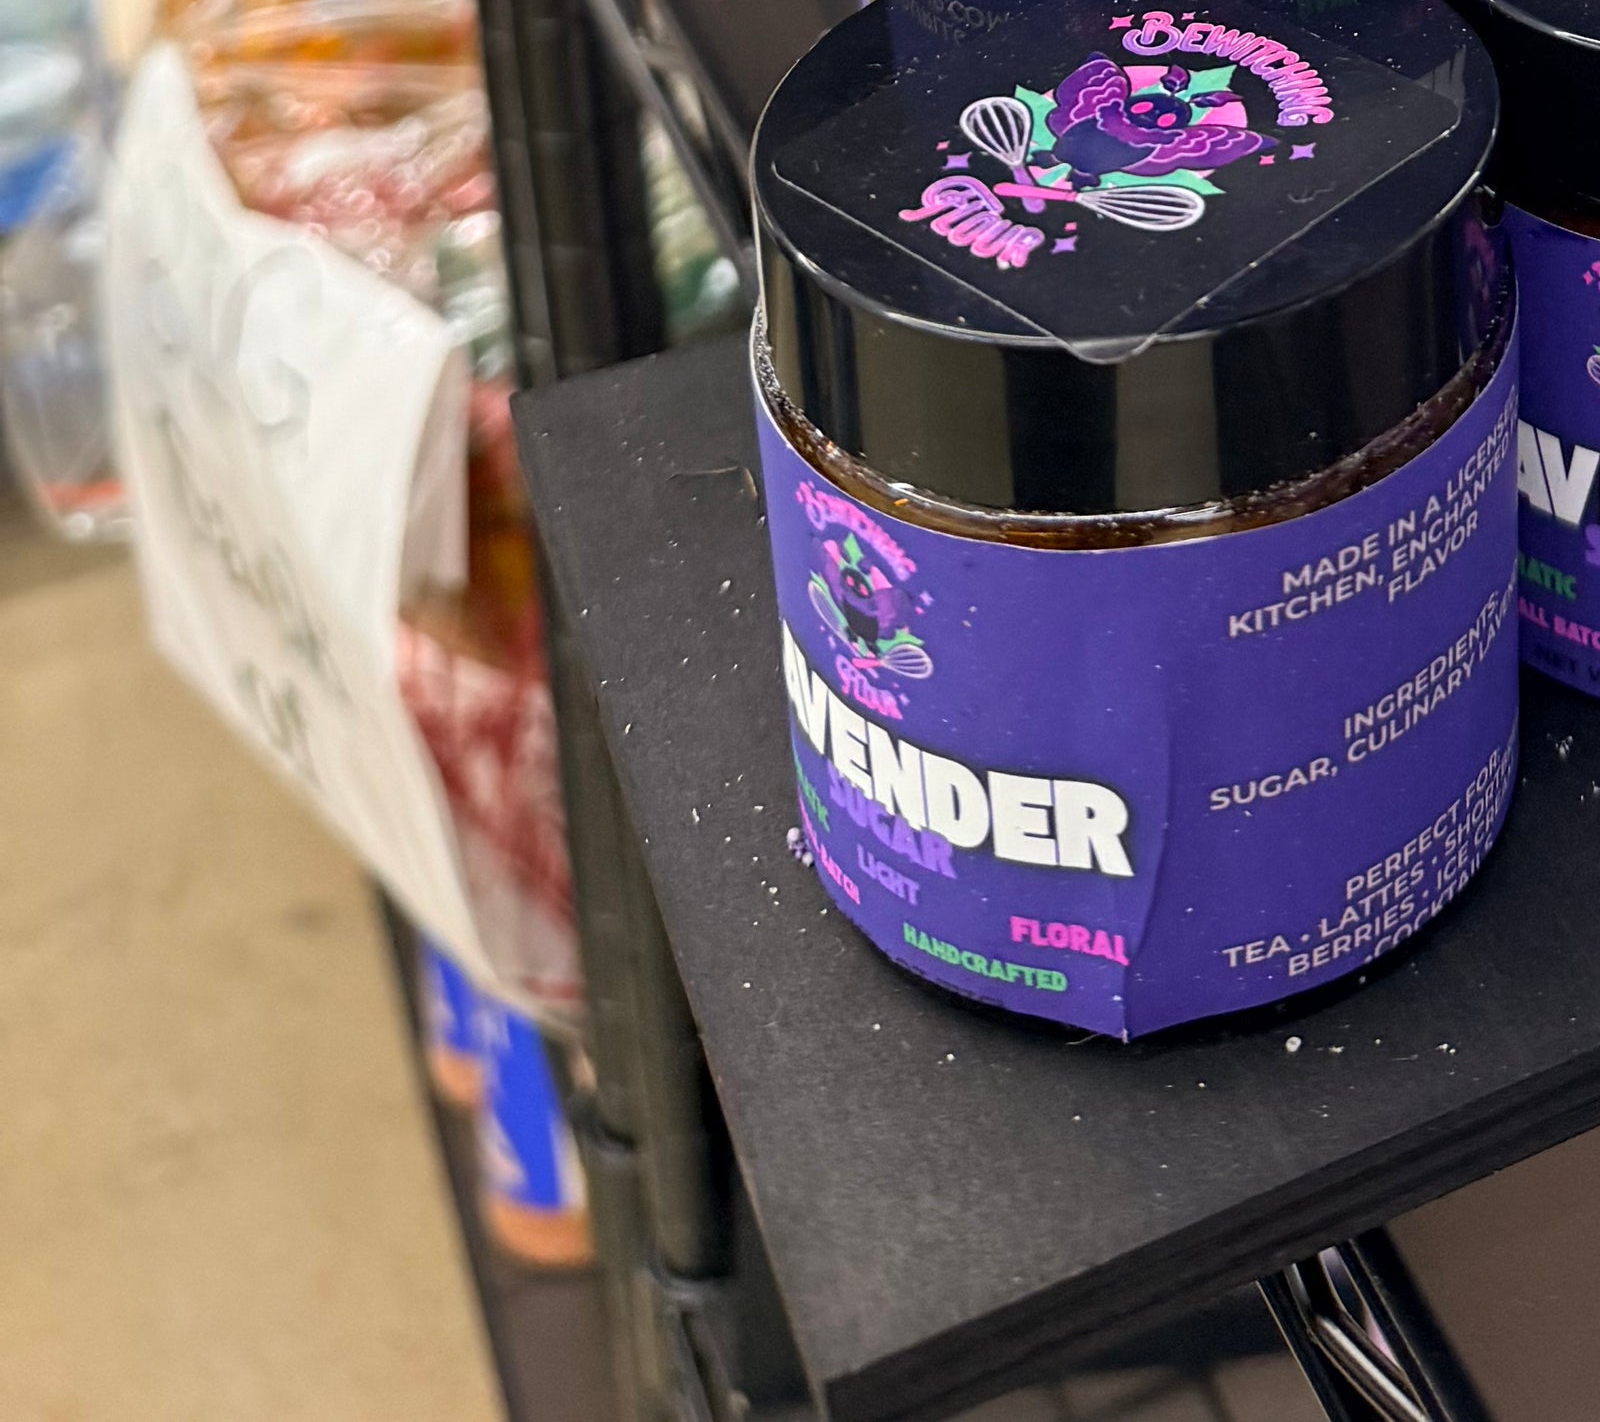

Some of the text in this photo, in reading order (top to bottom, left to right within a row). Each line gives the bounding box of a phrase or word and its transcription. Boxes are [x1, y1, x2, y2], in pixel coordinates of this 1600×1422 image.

[1121, 11, 1335, 129] BEWITCHING
[898, 175, 1046, 270] FLOUR
[1229, 430, 1510, 640] KITCHEN, ENCHANTED
[1282, 532, 1381, 597] MADE
[1387, 512, 1417, 549] IN
[1423, 492, 1441, 525] A
[1387, 507, 1480, 603] FLAVOR
[1209, 651, 1477, 812] SUGAR, CULINARY
[1345, 798, 1461, 902] PERFECT
[902, 922, 1068, 993] HANDCRAFTED
[1009, 915, 1131, 967] FLORAL
[1222, 861, 1425, 978] TEA LATTES
[1287, 839, 1470, 978] BERRIES ICE
